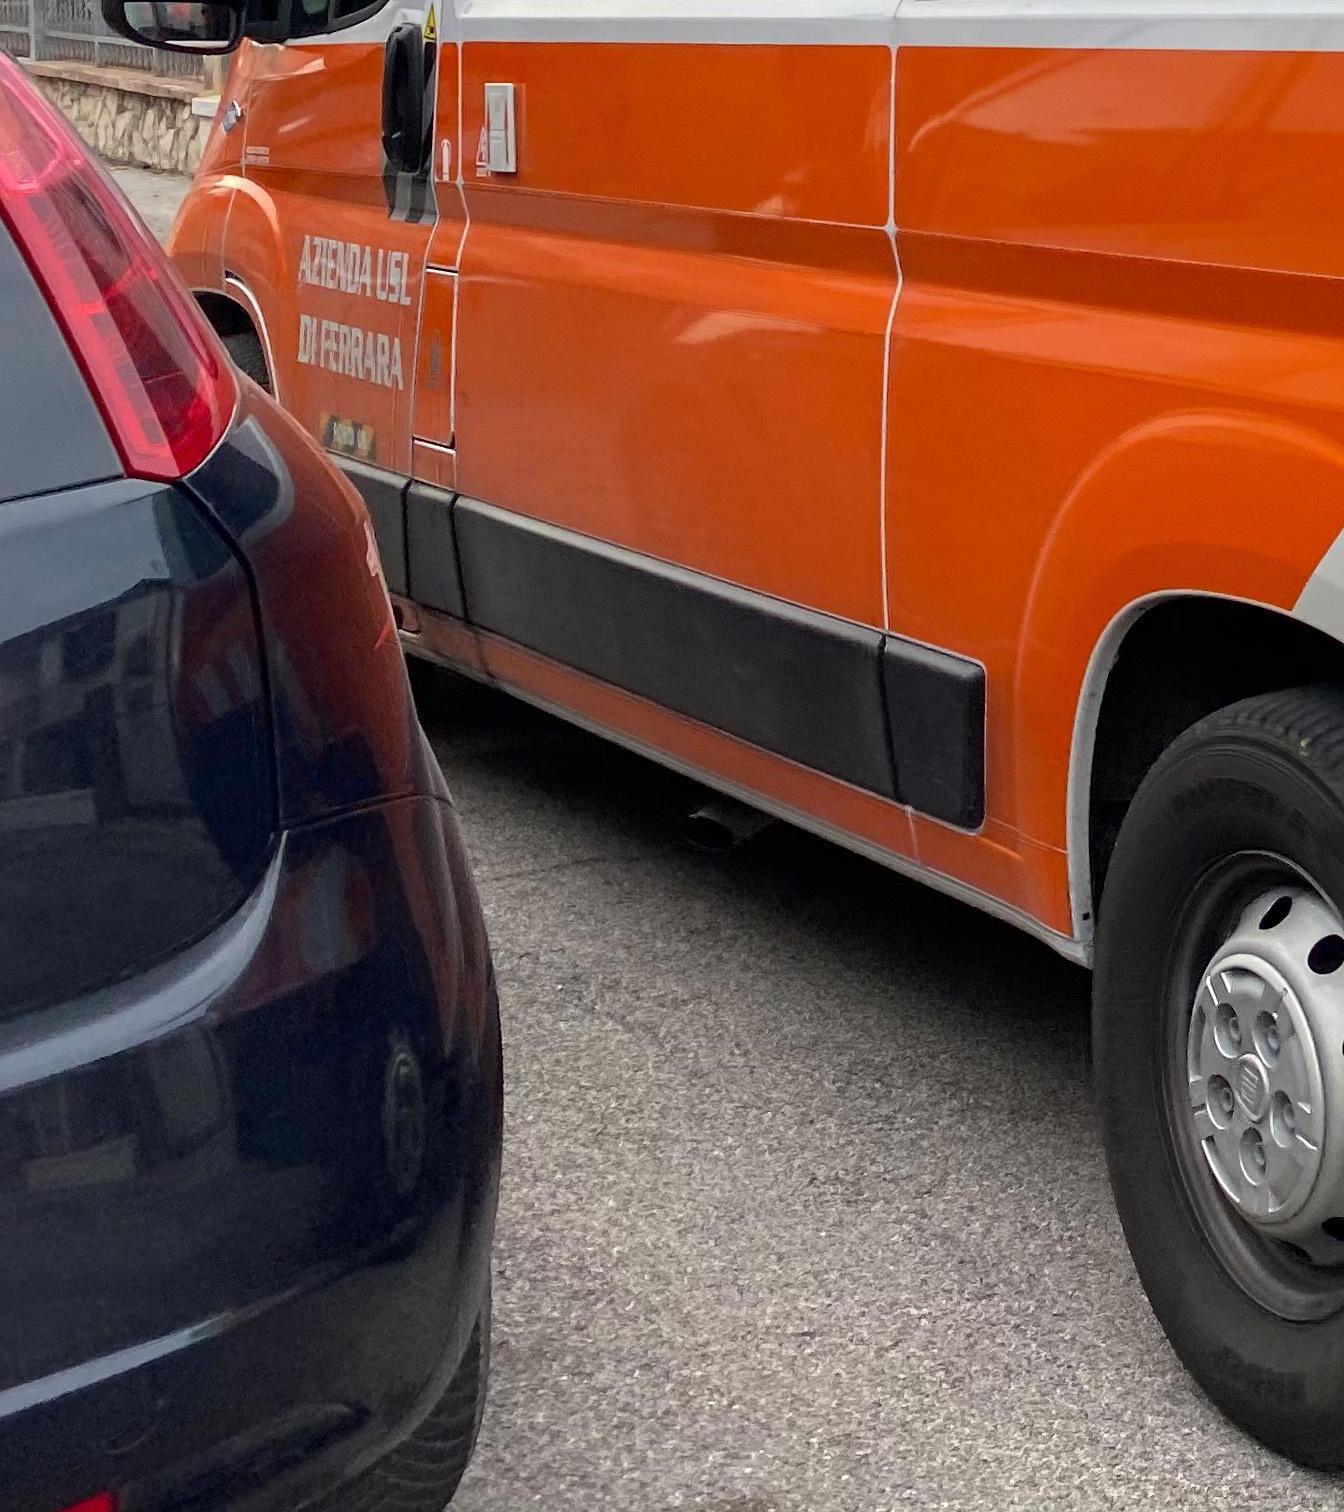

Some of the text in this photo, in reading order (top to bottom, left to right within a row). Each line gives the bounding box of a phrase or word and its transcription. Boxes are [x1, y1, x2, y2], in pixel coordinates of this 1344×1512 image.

[298, 234, 411, 305] AZIENDA USL
[297, 314, 404, 391] DI FERRARA
